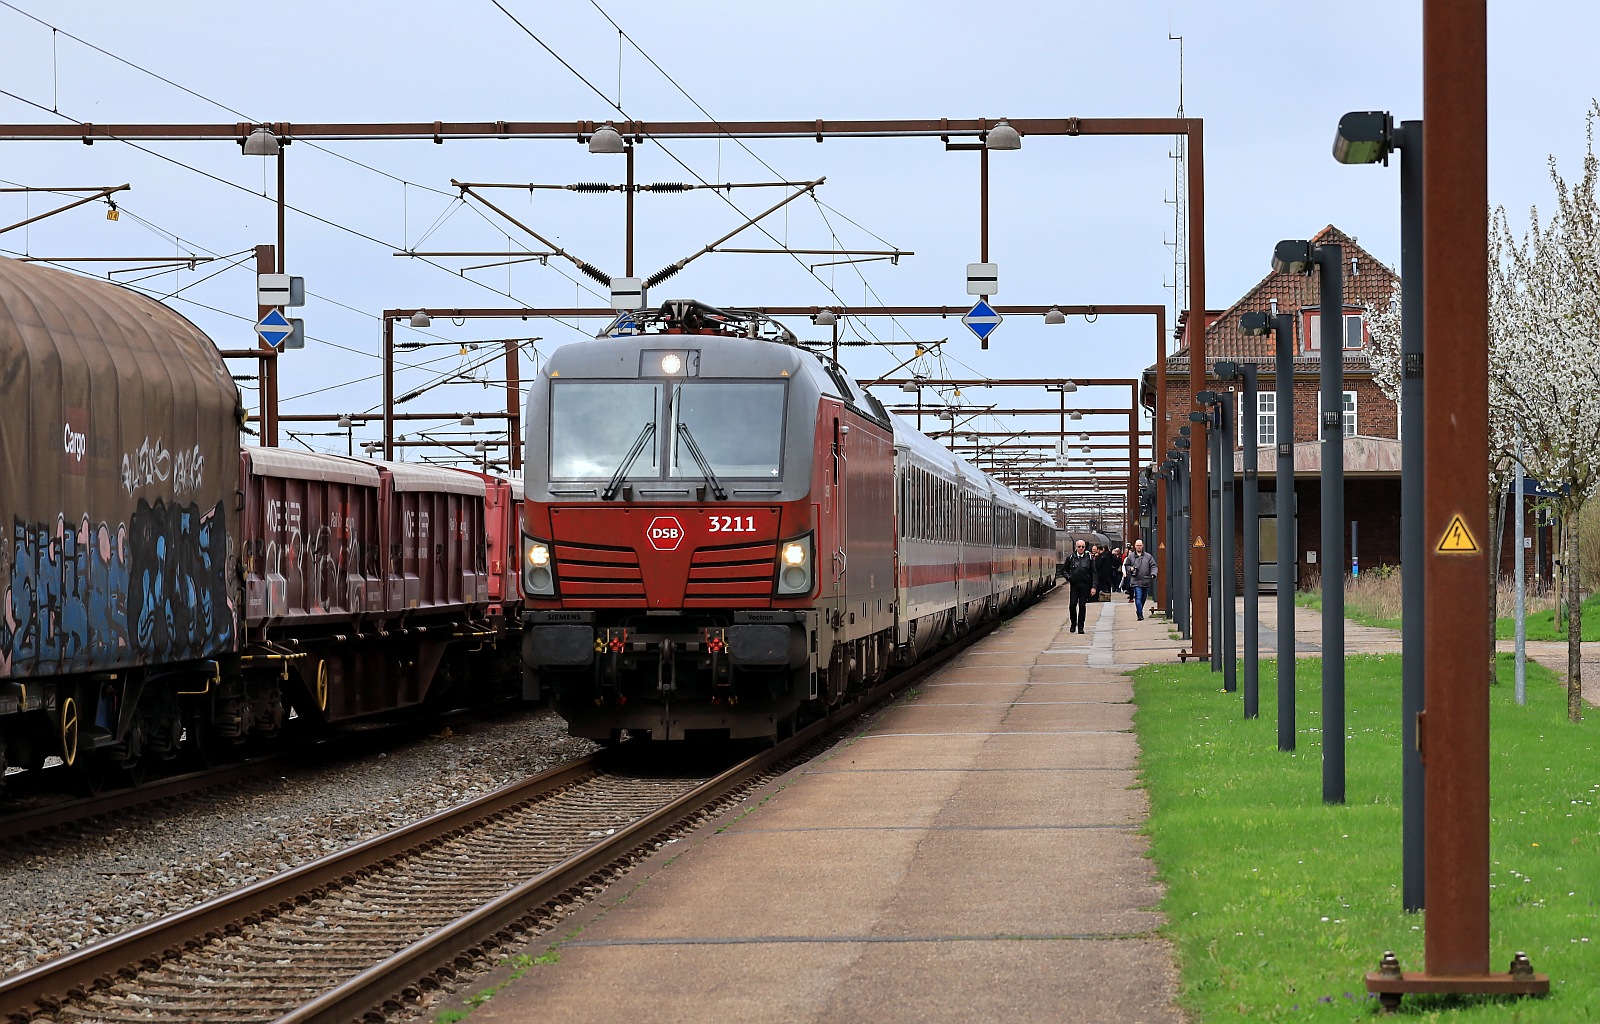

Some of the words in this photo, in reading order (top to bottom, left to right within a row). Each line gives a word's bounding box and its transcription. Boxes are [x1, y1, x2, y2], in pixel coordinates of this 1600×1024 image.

[64, 422, 86, 462] Cargo
[708, 516, 756, 532] 3211
[652, 528, 679, 539] DSB
[547, 613, 581, 621] SIEMENS
[747, 613, 774, 621] Vectron
